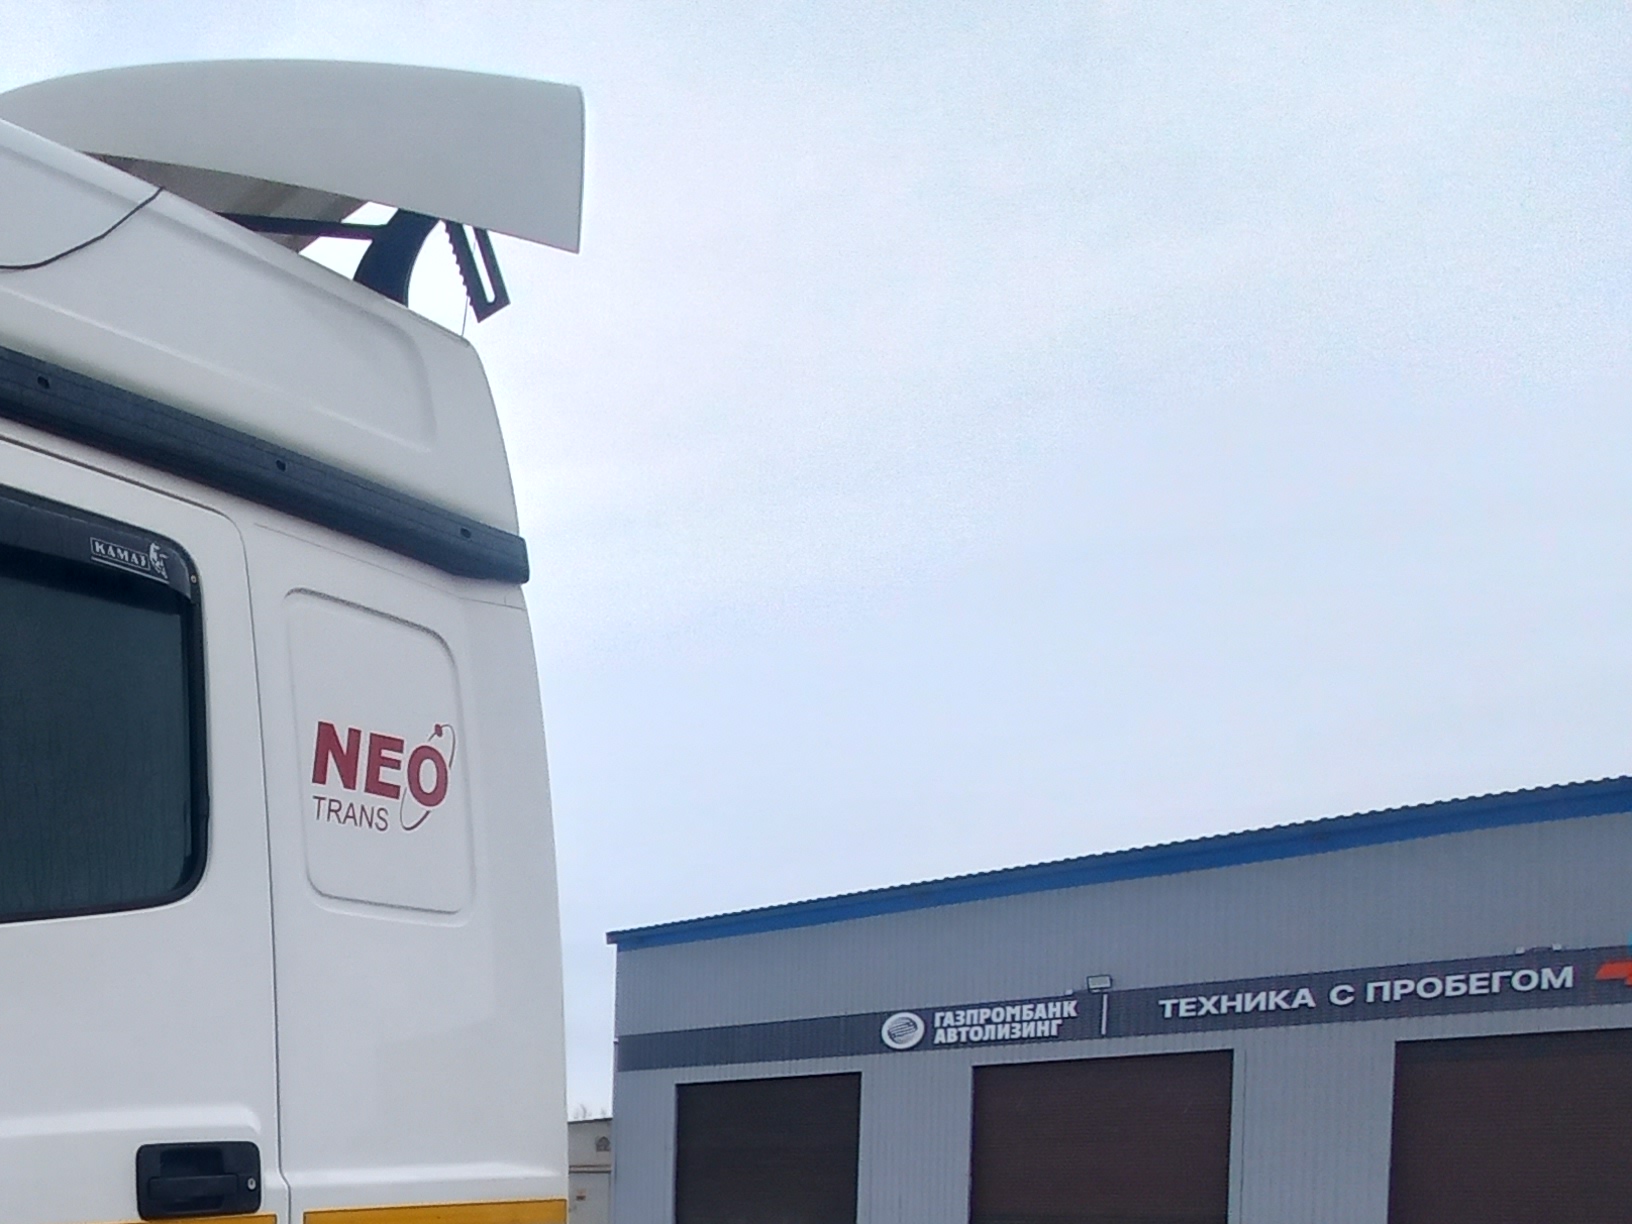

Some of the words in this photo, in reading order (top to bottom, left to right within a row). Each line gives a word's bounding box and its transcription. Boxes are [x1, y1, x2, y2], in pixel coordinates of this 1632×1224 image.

[312, 721, 448, 807] NEO
[312, 796, 389, 832] TRANS
[1158, 988, 1316, 1018] ТЕХНИКА
[1329, 984, 1355, 1006] С
[1366, 966, 1573, 1003] ПРОБЕГОМ
[933, 1019, 1063, 1044] АВТОЛИЗИНГ
[934, 1000, 1078, 1028] ГАЗПРОМБАНК
